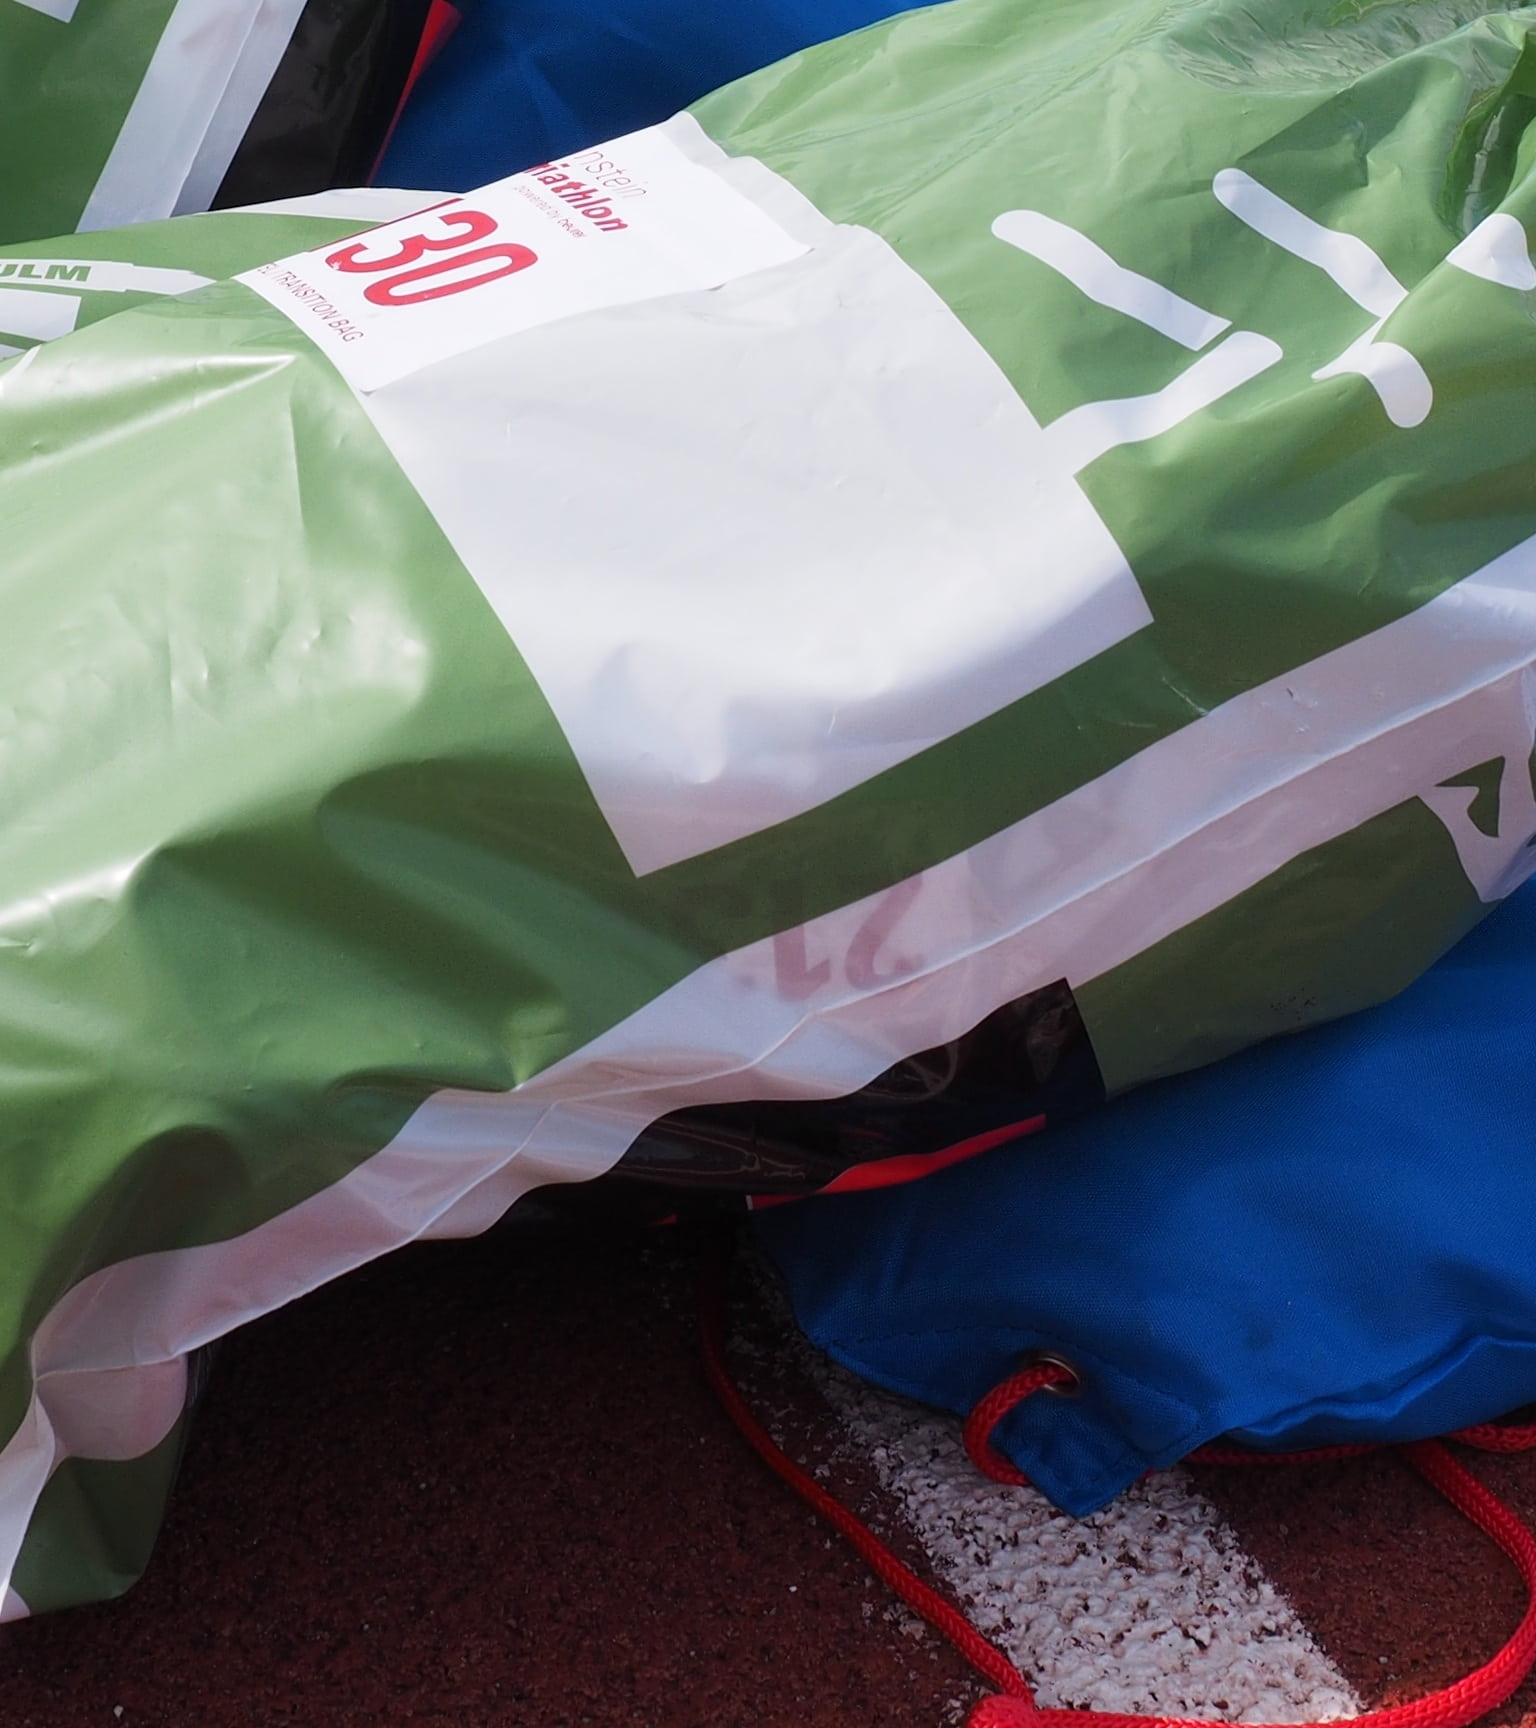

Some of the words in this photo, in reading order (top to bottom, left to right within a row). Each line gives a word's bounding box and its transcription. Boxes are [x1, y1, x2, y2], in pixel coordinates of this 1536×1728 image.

[572, 148, 648, 200] nstein
[309, 198, 539, 307] 30
[280, 269, 340, 325] TRANSITION
[329, 316, 367, 344] BAG
